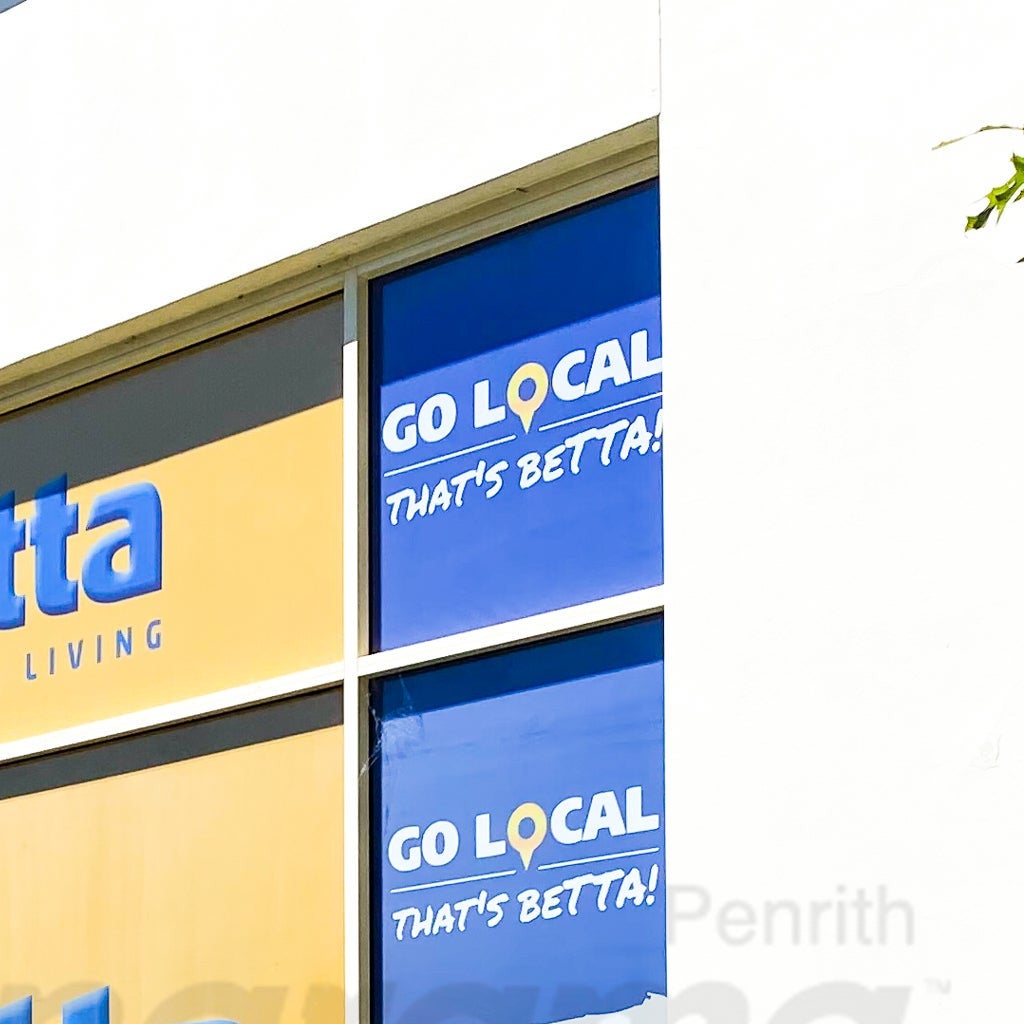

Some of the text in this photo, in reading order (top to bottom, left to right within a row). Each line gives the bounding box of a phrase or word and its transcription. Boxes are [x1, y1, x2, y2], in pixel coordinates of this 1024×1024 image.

[382, 330, 663, 453] GO LOCAL
[386, 408, 663, 525] THAT'S BETTA!
[26, 620, 163, 680] LIVING
[388, 786, 660, 872] GO LOCAL
[392, 863, 659, 941] THAT'S BETTA!
